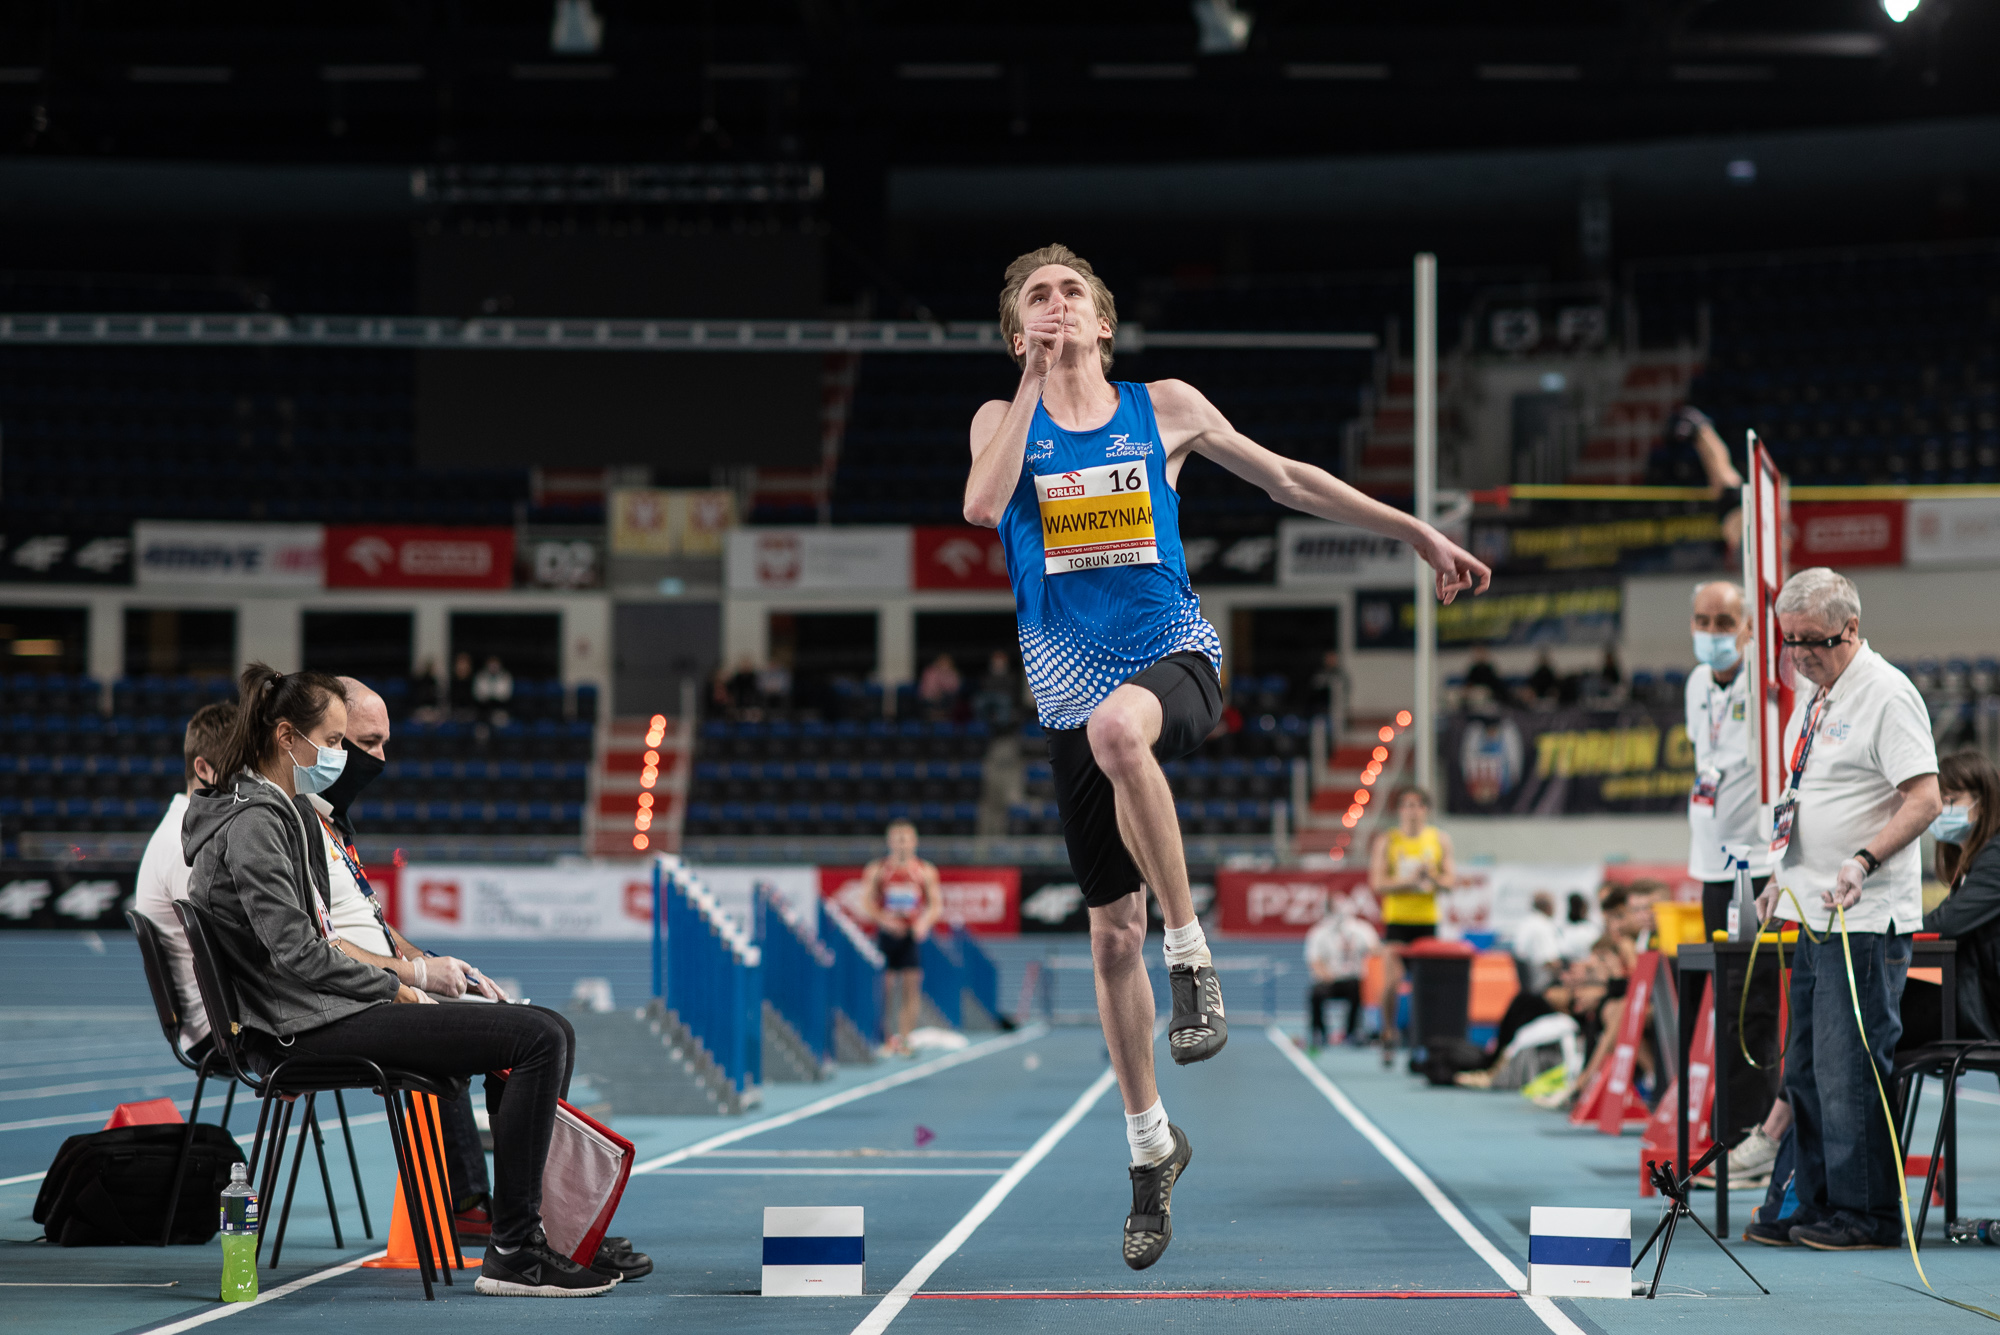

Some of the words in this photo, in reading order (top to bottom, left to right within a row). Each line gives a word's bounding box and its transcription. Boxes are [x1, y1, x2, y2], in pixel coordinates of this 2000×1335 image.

[1109, 468, 1141, 492] 16
[1049, 486, 1083, 497] ORLEN
[1068, 552, 1110, 569] TORUŃ
[1113, 551, 1140, 564] 2021
[1172, 962, 1186, 971] NIKE
